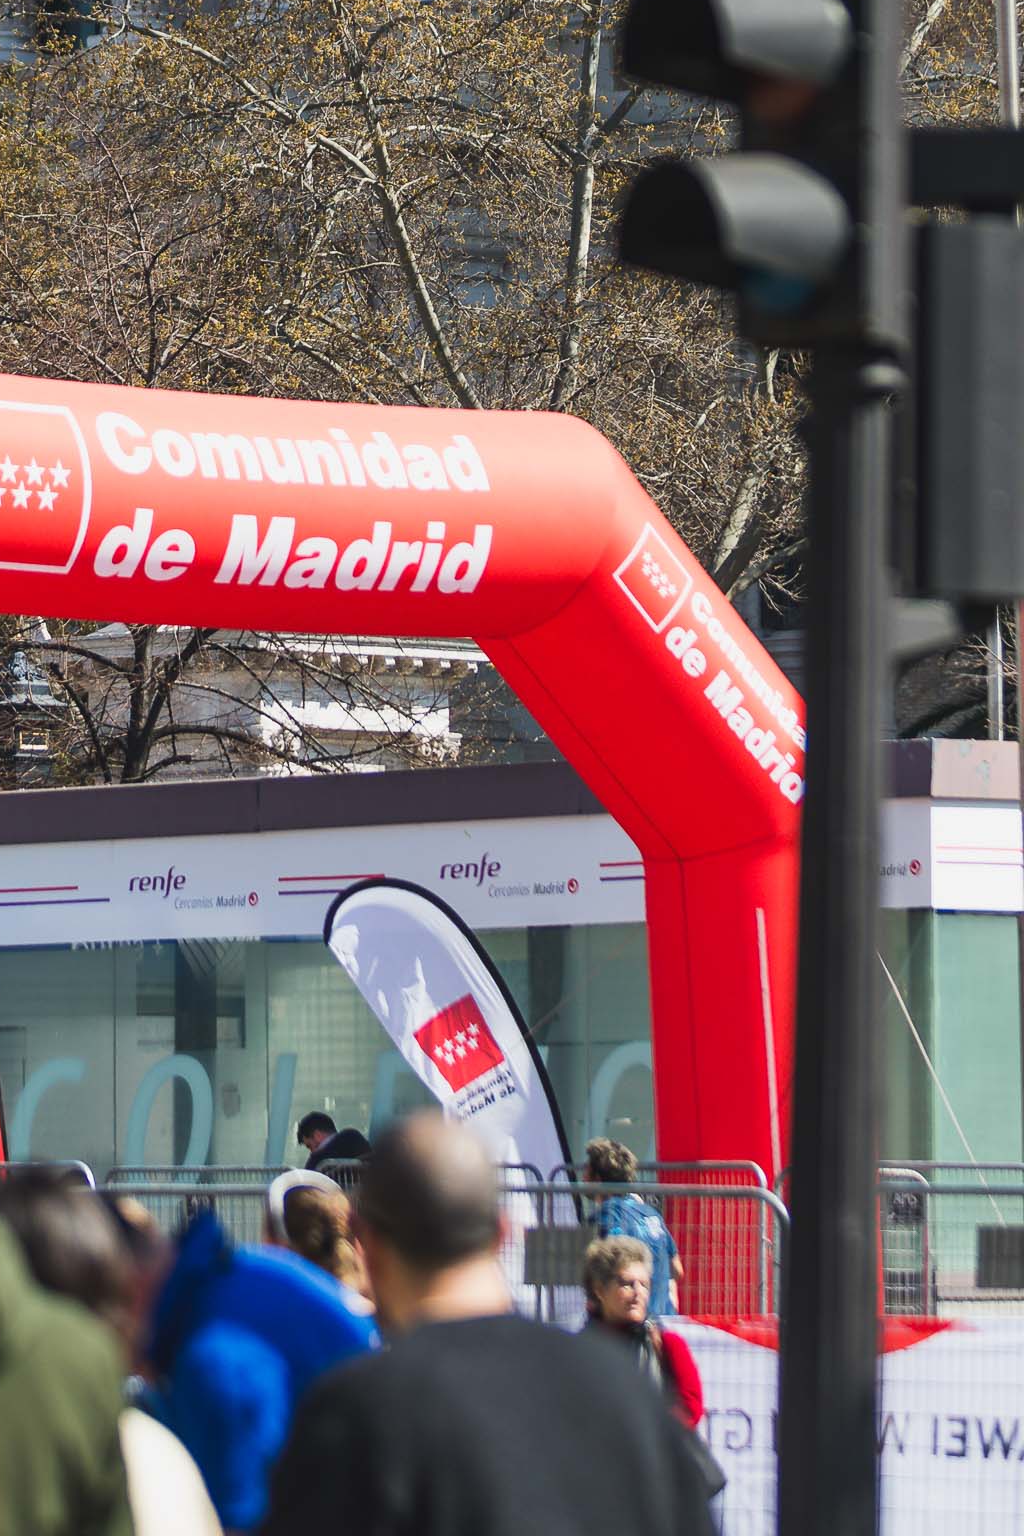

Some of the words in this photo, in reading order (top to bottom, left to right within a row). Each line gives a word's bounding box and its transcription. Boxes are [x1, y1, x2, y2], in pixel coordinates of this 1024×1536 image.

[94, 410, 491, 494] Comunidad
[93, 507, 198, 582] de
[214, 514, 493, 595] Madrid
[664, 626, 707, 678] de
[690, 591, 807, 752] Comunida
[128, 864, 187, 898] renfe
[439, 852, 502, 887] renfe
[880, 861, 906, 877] adrid
[215, 893, 247, 908] Madrid
[533, 880, 565, 895] Madrid
